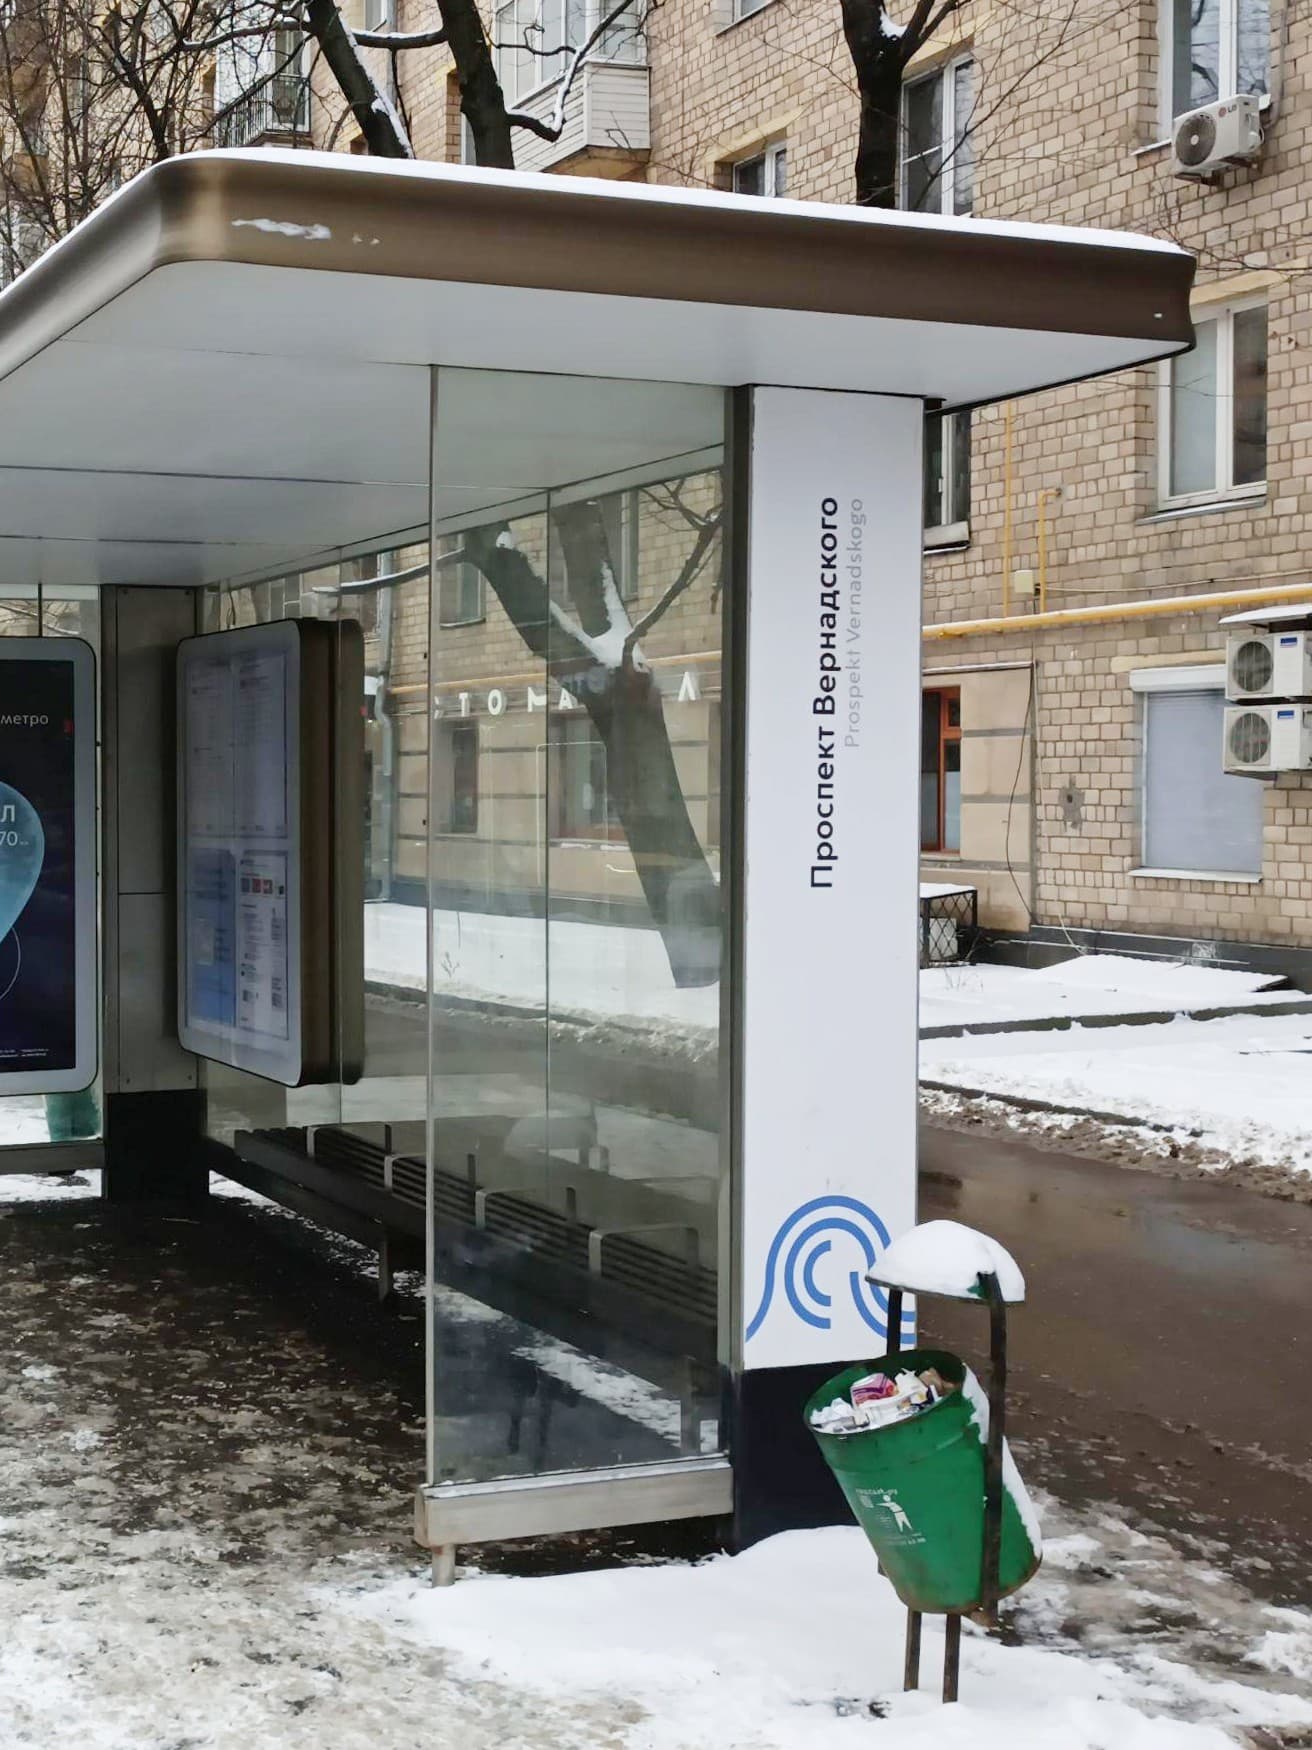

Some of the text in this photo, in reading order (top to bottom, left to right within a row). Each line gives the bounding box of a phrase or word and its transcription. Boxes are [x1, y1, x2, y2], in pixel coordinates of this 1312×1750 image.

[0, 714, 49, 727] метро
[810, 497, 841, 888] Проспект Вернадского
[844, 499, 866, 748] Prospekt Vernadskogo
